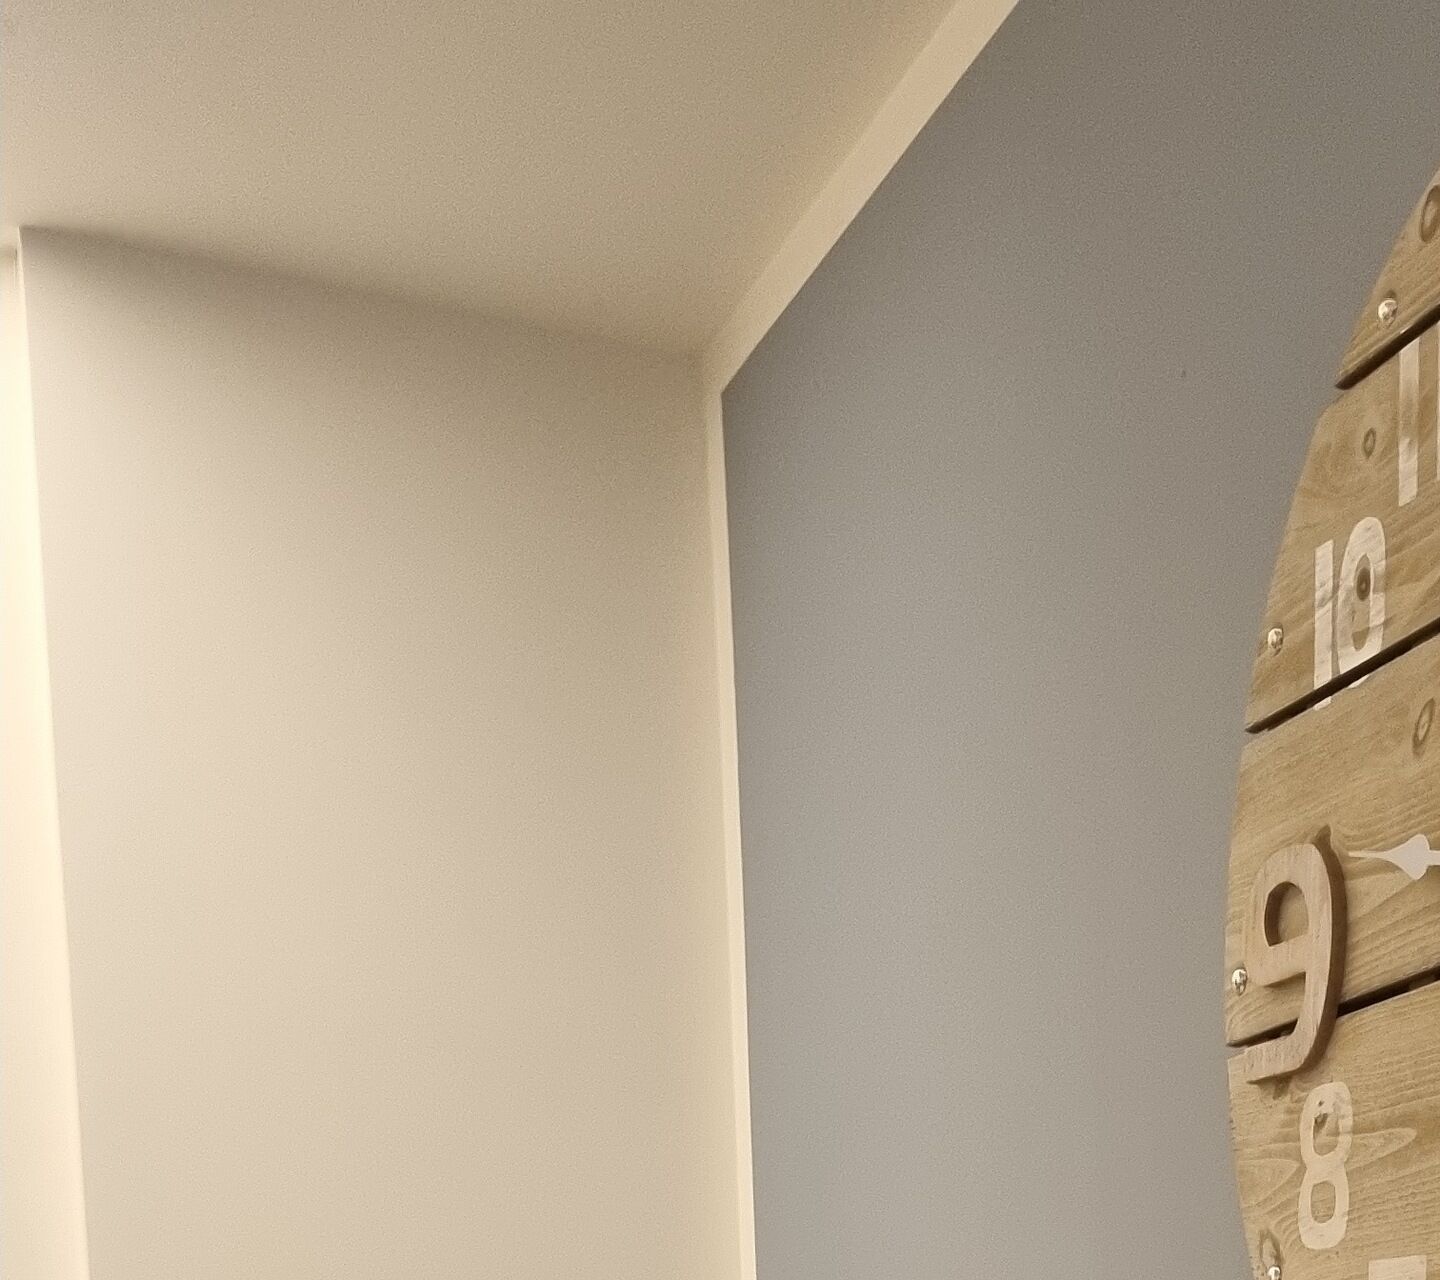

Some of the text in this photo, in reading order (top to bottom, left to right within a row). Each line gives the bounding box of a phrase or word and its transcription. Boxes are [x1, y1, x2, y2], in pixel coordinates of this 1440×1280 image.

[1313, 516, 1387, 710] 10
[1245, 840, 1346, 1085] 9
[1298, 1080, 1354, 1251] 8
